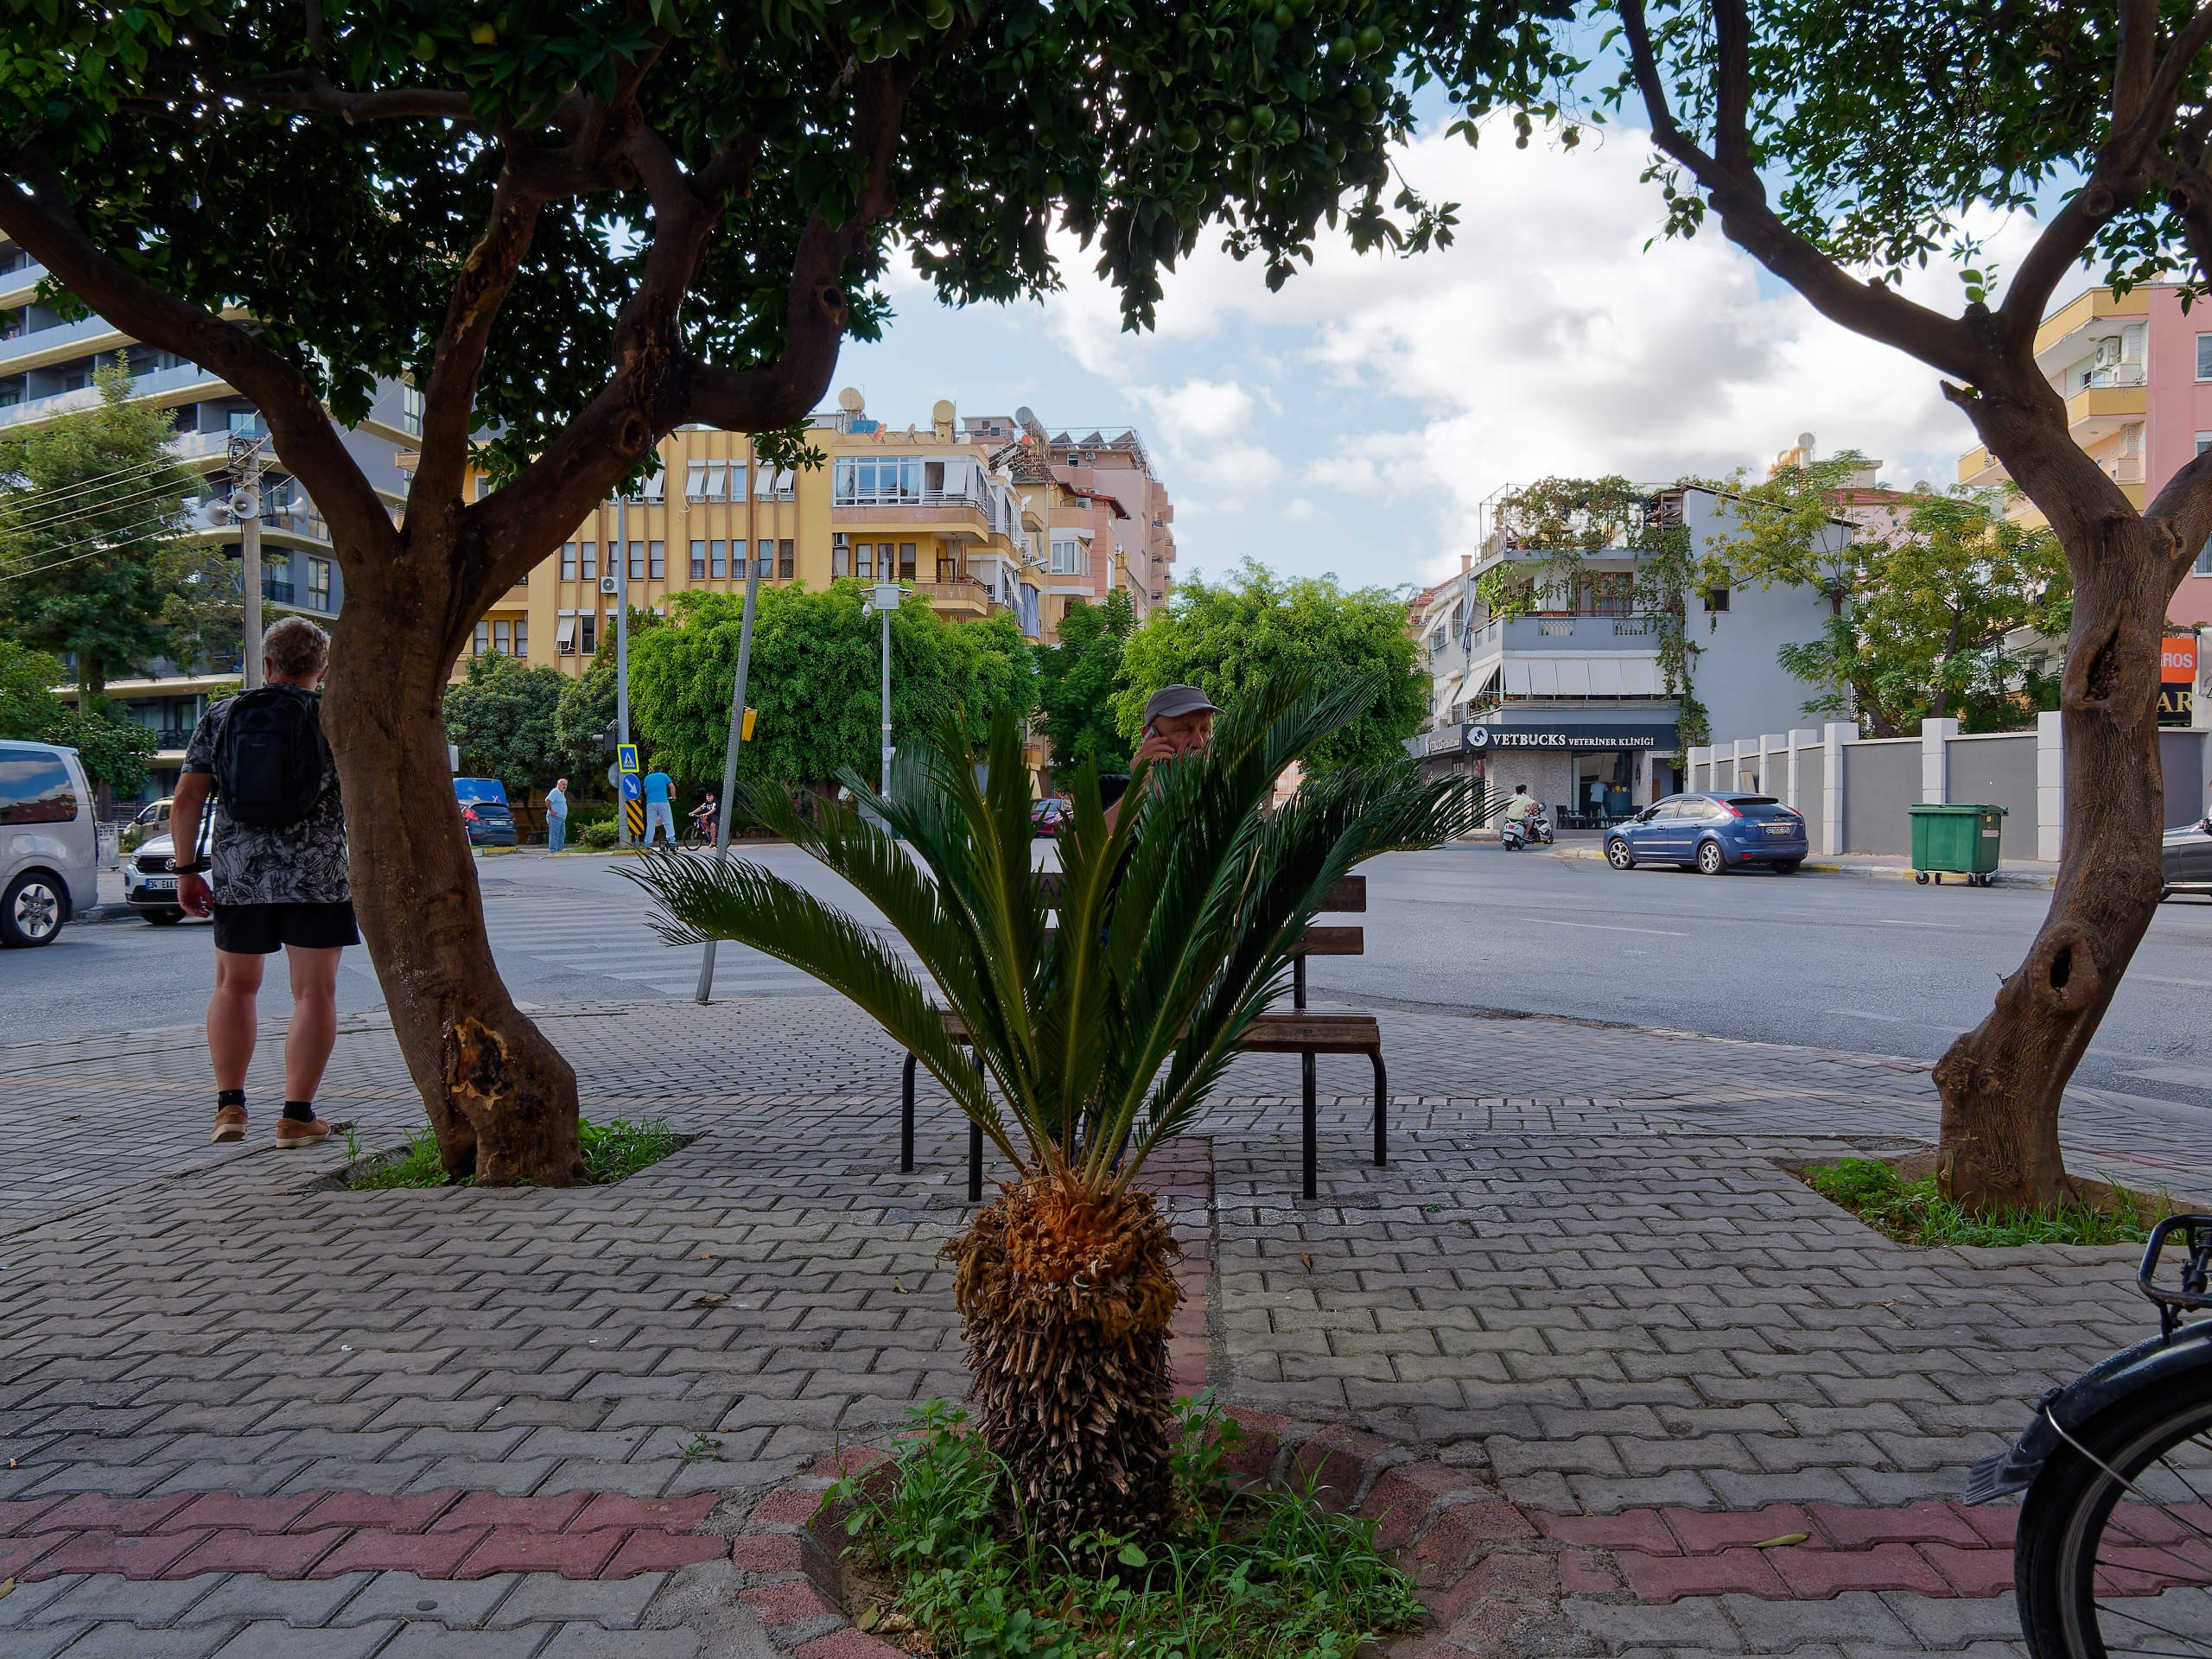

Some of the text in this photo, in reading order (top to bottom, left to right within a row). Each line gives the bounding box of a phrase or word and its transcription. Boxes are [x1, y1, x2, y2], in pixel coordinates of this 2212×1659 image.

[2161, 652, 2193, 668] ROS
[1491, 734, 1655, 746] VETBUCKS VETERİNER KLİNİĞİ
